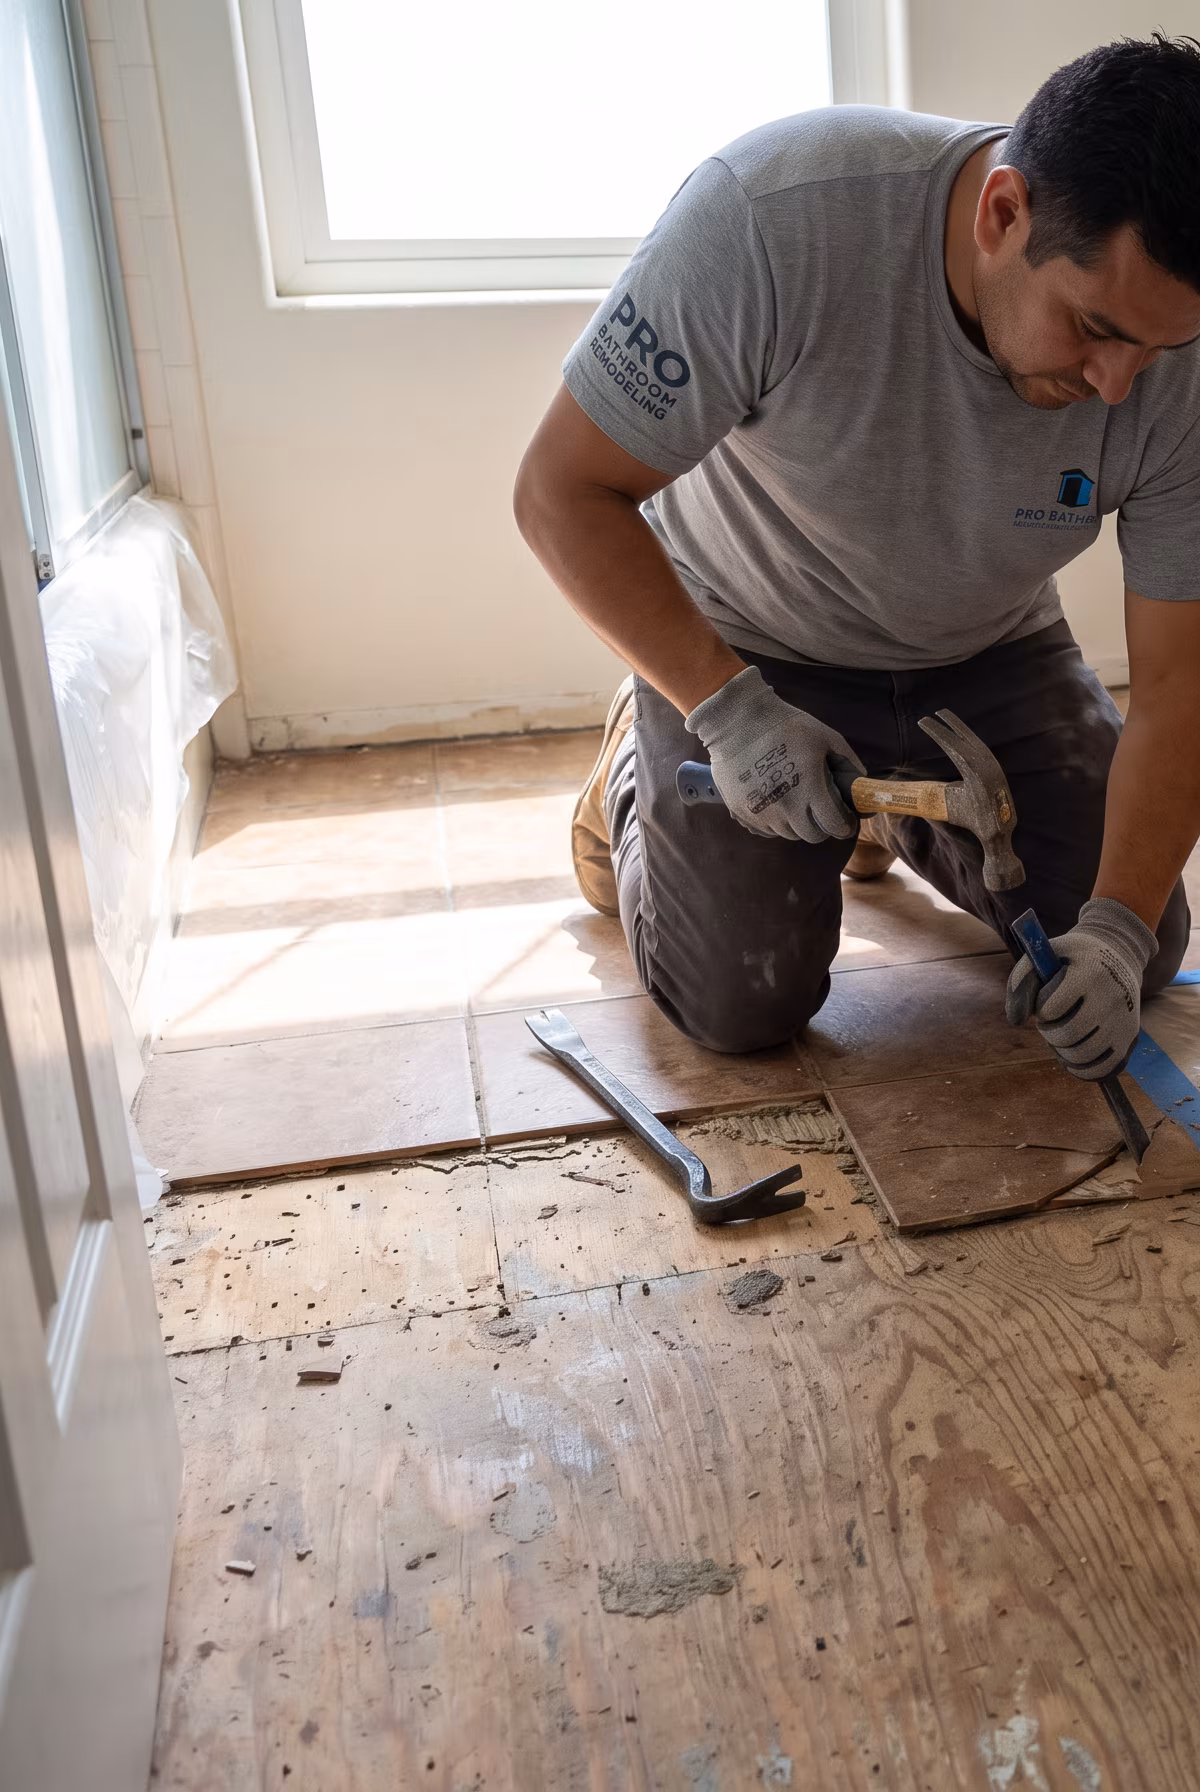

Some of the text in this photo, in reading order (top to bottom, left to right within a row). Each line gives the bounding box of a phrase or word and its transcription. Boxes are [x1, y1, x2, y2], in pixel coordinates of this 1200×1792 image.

[590, 337, 667, 420] REMODELING
[598, 324, 678, 408] BATHROOM
[609, 292, 691, 388] PRO
[1015, 508, 1045, 520] PRO
